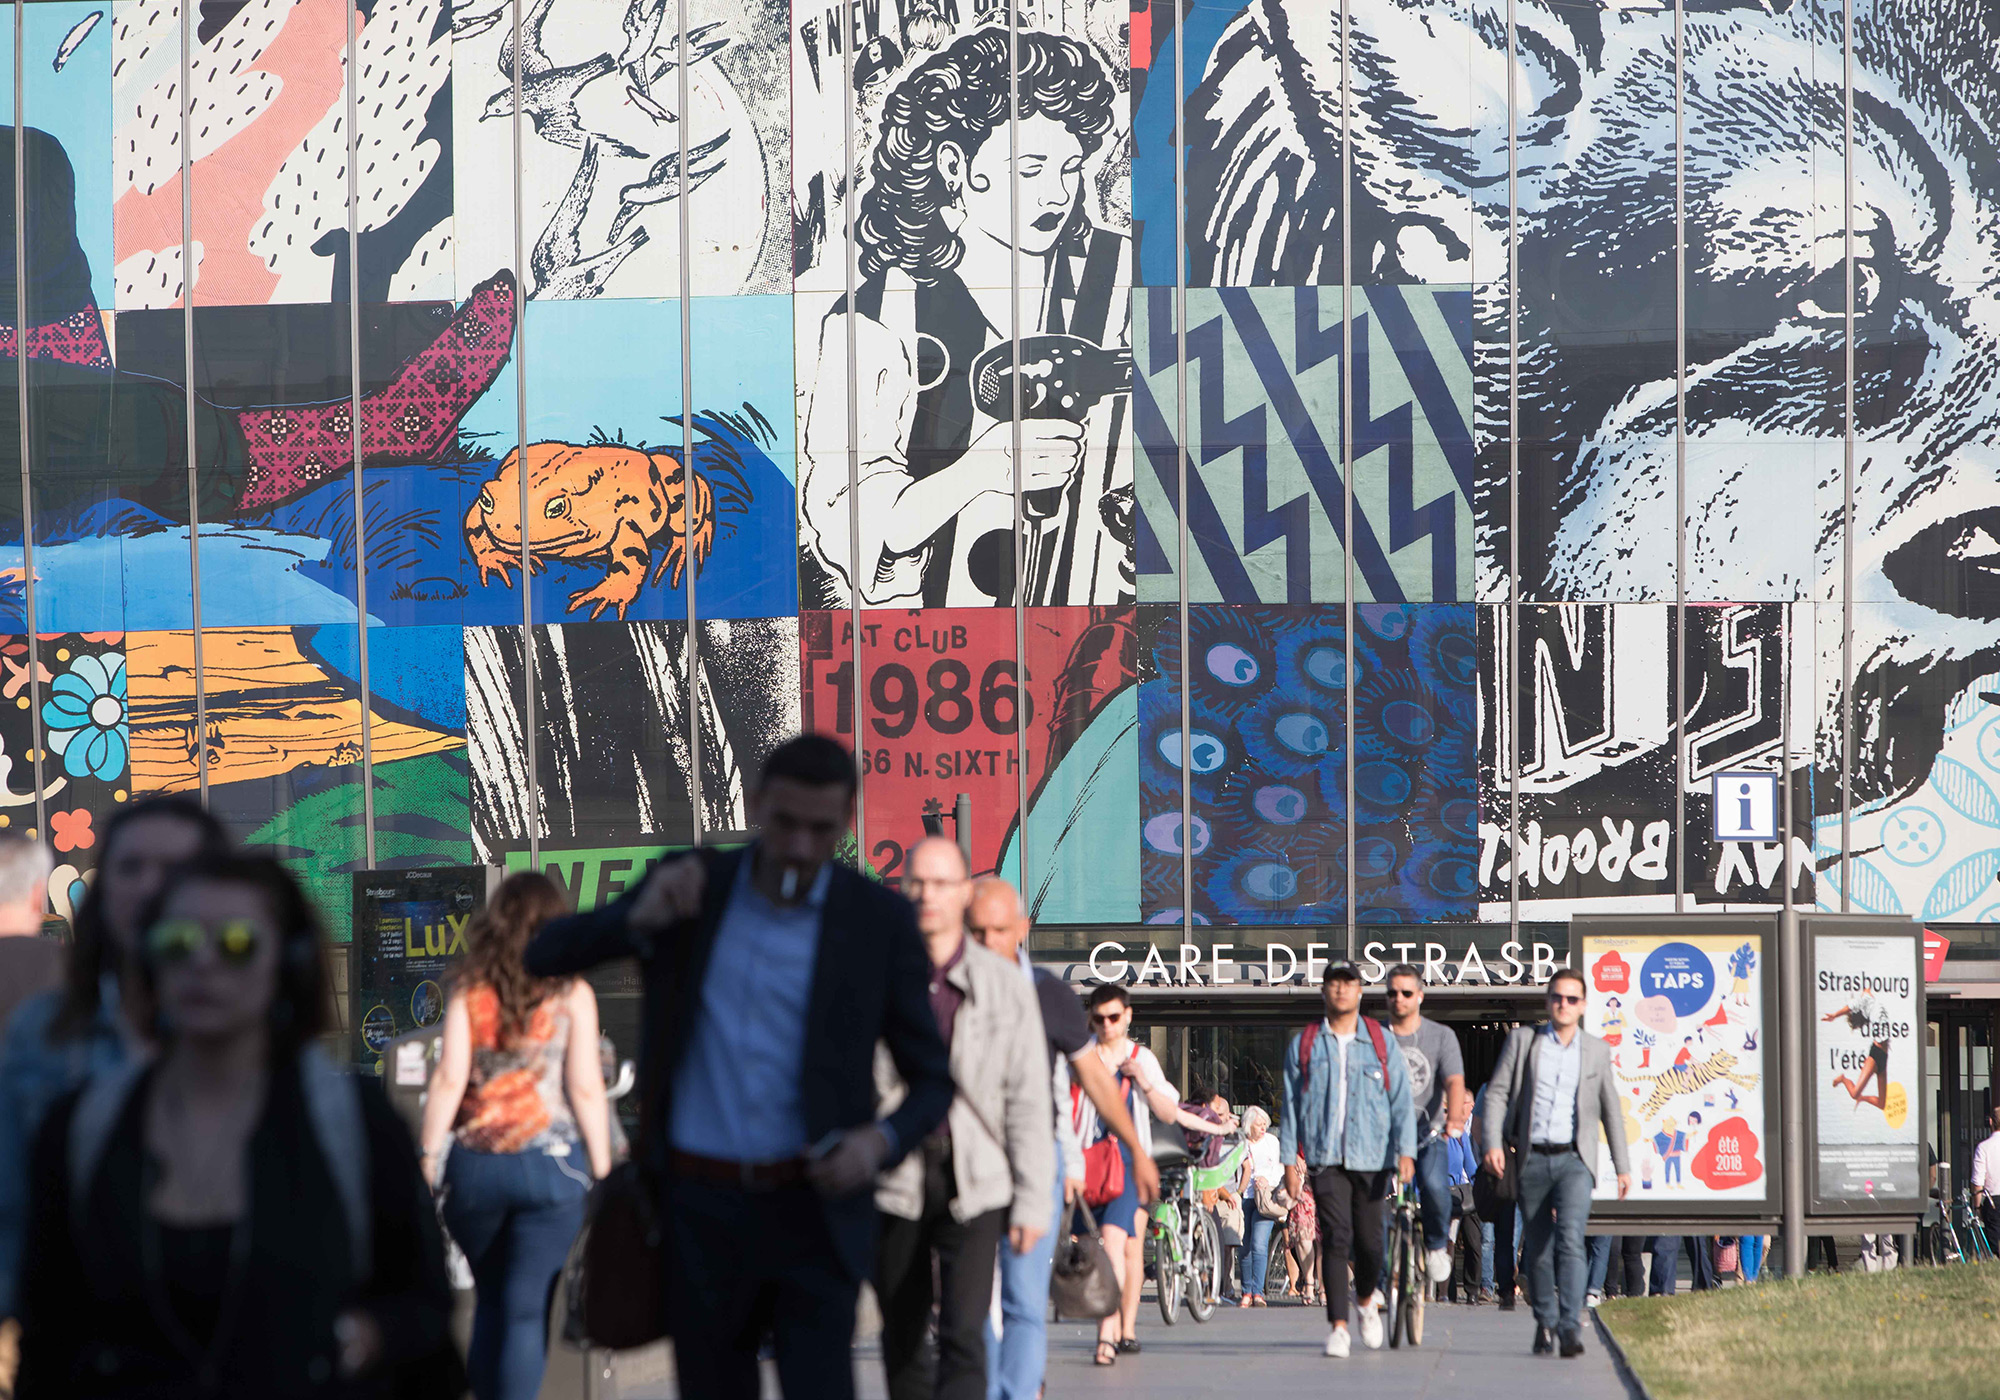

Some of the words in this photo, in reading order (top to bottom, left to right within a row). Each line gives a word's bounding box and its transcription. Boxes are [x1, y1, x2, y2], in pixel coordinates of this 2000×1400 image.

[826, 0, 881, 57] NEW
[841, 621, 882, 647] AT
[894, 625, 967, 654] CLUB
[826, 658, 1034, 739] 1986
[935, 749, 1030, 779] SIXTH
[543, 857, 658, 914] NE
[405, 913, 471, 957] LuX
[1089, 941, 1234, 984] GARE
[1266, 943, 1328, 983] DE
[1360, 941, 1570, 983] STRASB
[1650, 972, 1704, 989] TAPS
[1819, 970, 1909, 998] Strasbourg
[1860, 1019, 1909, 1038] danse
[1718, 1135, 1740, 1154] été
[1715, 1154, 1743, 1171] 2018
